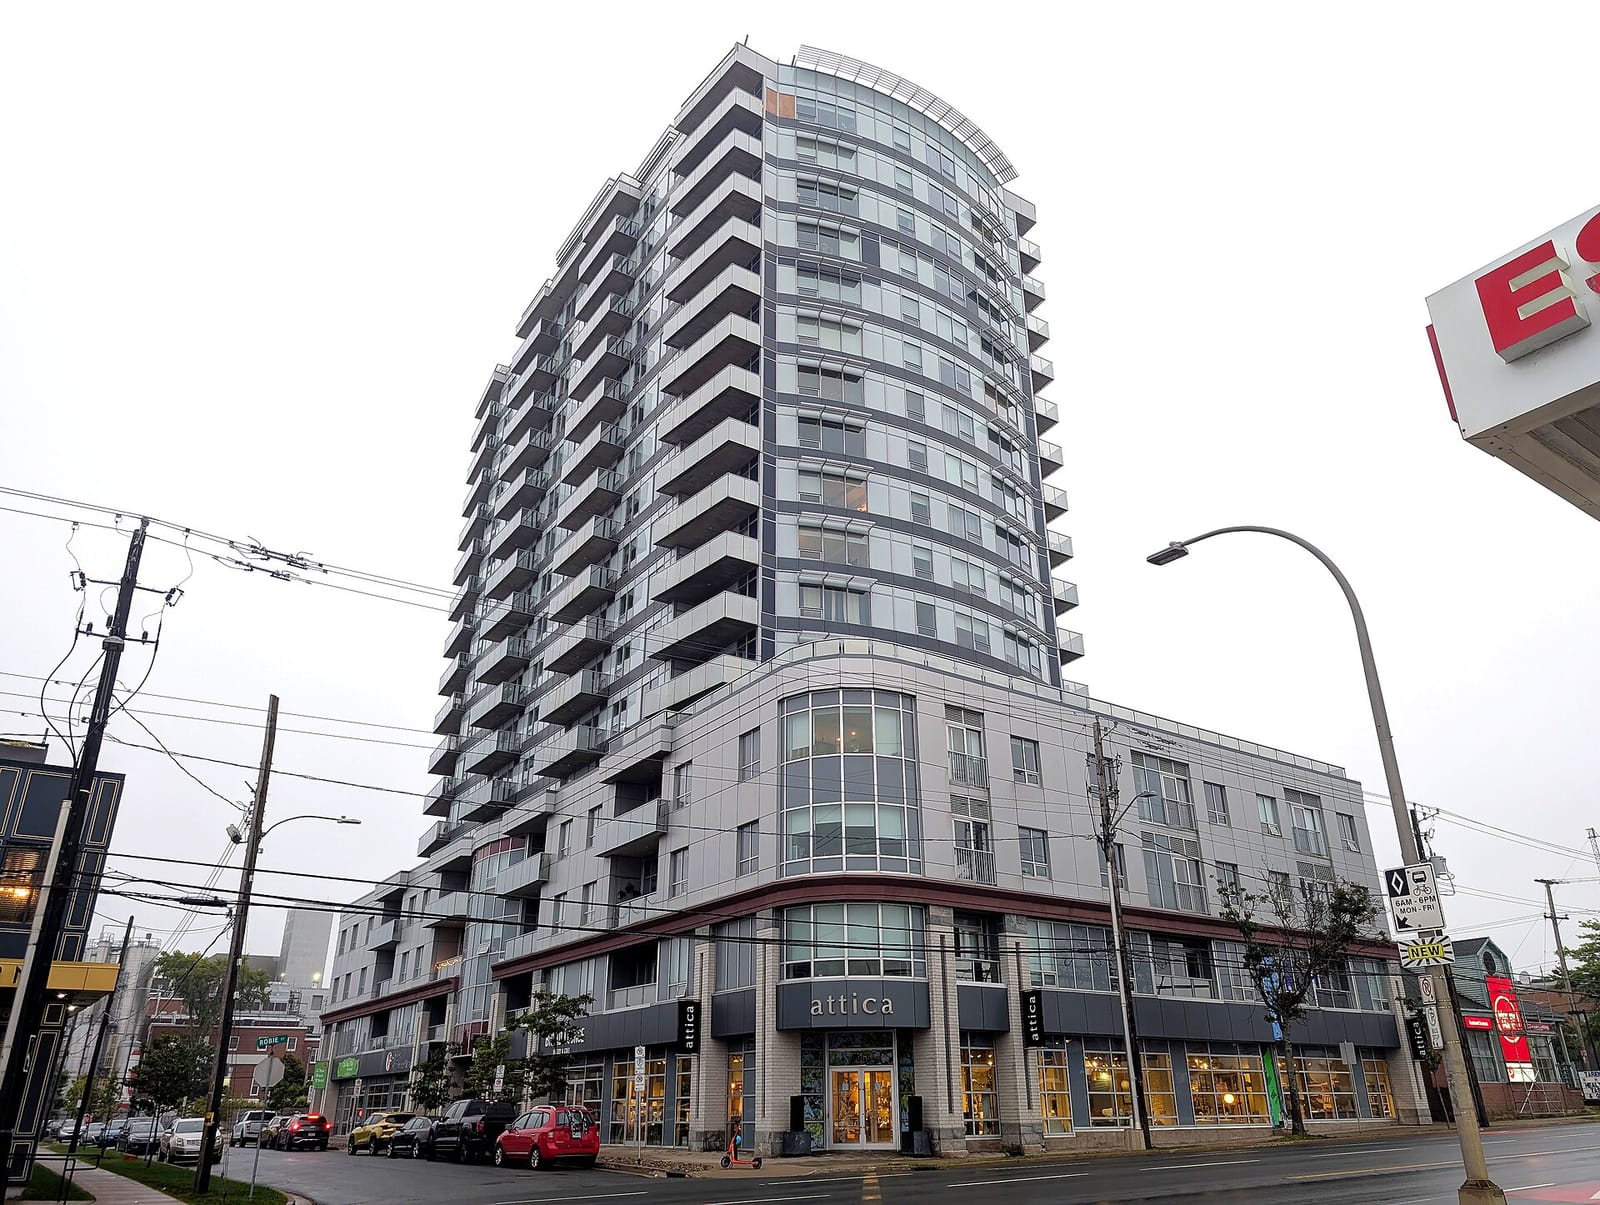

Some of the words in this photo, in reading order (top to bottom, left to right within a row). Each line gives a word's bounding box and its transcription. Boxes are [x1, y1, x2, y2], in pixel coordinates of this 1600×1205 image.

[1395, 898, 1412, 907] 6AM
[1418, 895, 1437, 904] 6PM
[1400, 906, 1417, 914] MON
[1410, 945, 1440, 957] NEW
[810, 992, 894, 1015] attica
[684, 1006, 695, 1048] attica
[1028, 996, 1039, 1041] attica
[260, 1037, 279, 1046] ROBIE
[1413, 1022, 1426, 1056] attica
